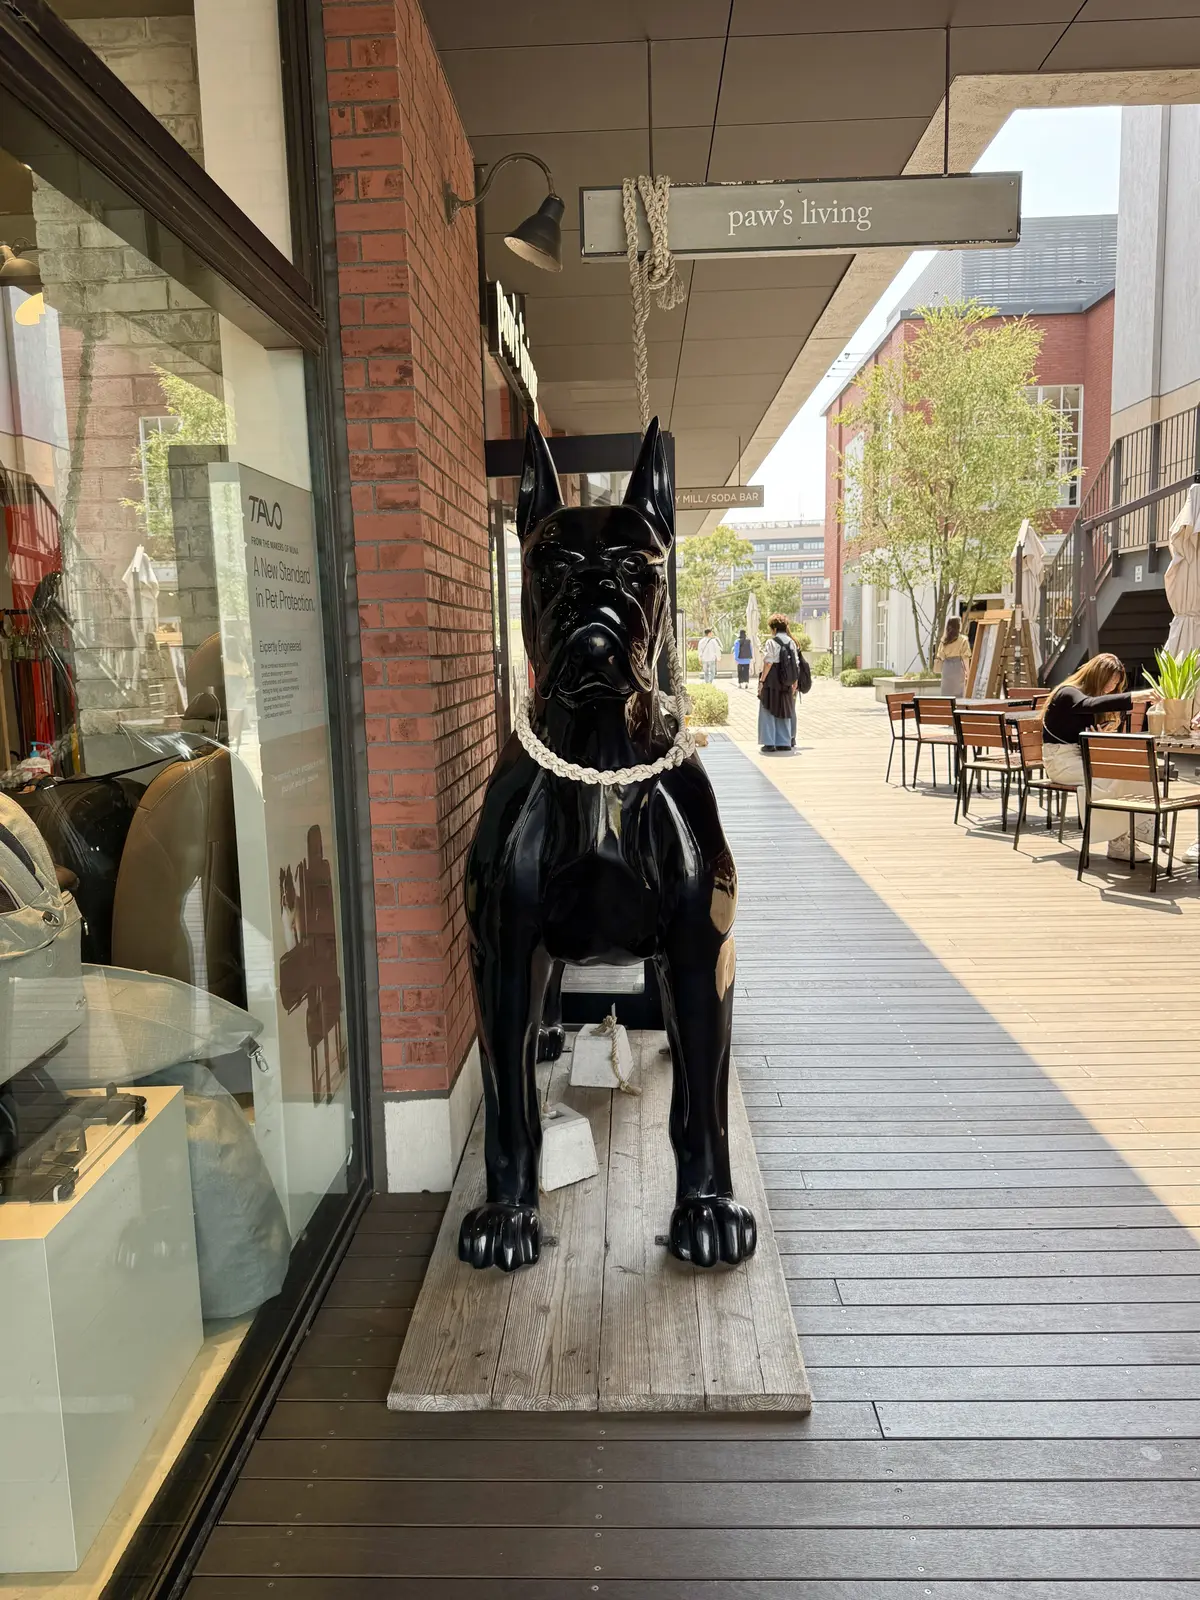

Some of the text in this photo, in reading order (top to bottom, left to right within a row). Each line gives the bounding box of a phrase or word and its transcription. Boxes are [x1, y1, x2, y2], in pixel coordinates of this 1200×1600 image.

[728, 198, 873, 236] paw's living
[682, 494, 703, 504] MILL
[711, 493, 737, 502] SODA
[739, 492, 759, 501] BAR
[253, 556, 311, 584] A New Standard
[255, 586, 264, 608] in
[265, 588, 279, 609] Pet
